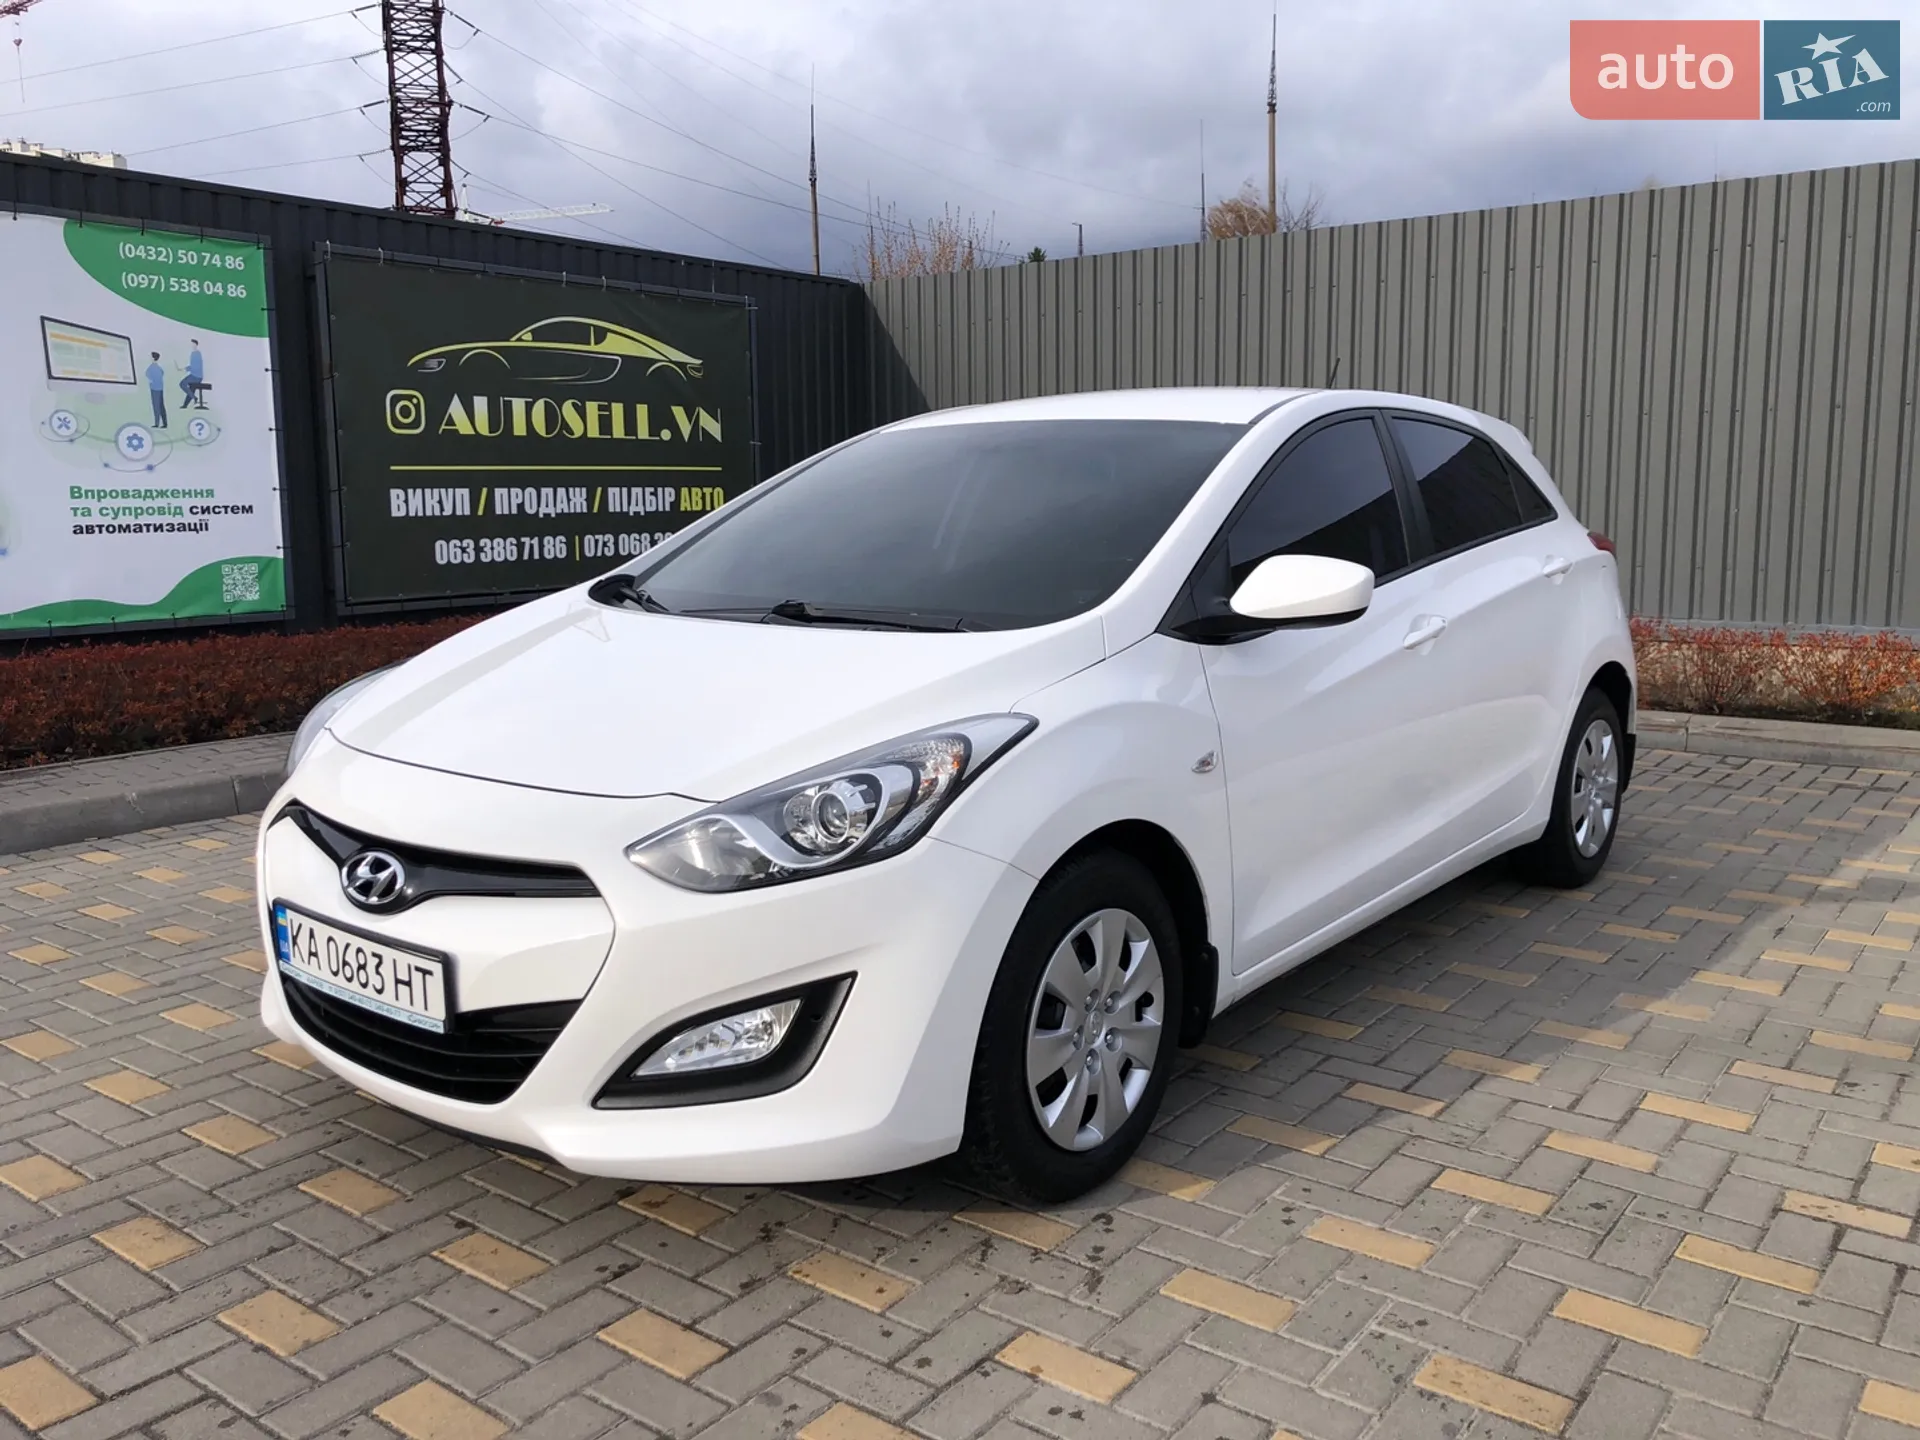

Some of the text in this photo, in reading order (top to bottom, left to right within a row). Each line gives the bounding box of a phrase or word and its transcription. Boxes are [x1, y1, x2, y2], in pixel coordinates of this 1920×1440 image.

[118, 241, 245, 270] (0432) 50 74 86
[121, 271, 247, 298] (097) 538 04 86
[438, 393, 723, 443] AUTOSELL.VN
[69, 485, 215, 502] Впровадження
[390, 487, 470, 517] ВИКУП
[494, 487, 588, 518] ПРОДАЖ
[607, 487, 676, 516] ПІДБІР
[680, 487, 724, 512] АВТО
[70, 503, 254, 519] та супровід систем
[72, 518, 209, 535] автоматизації
[434, 538, 475, 565] 063
[480, 537, 518, 563] 386
[521, 537, 539, 560] 71
[543, 535, 567, 559] 86
[583, 533, 615, 557] 073
[618, 532, 651, 556] 068
[290, 918, 323, 971] KA
[326, 935, 386, 995] 0683
[393, 958, 434, 1012] HT
